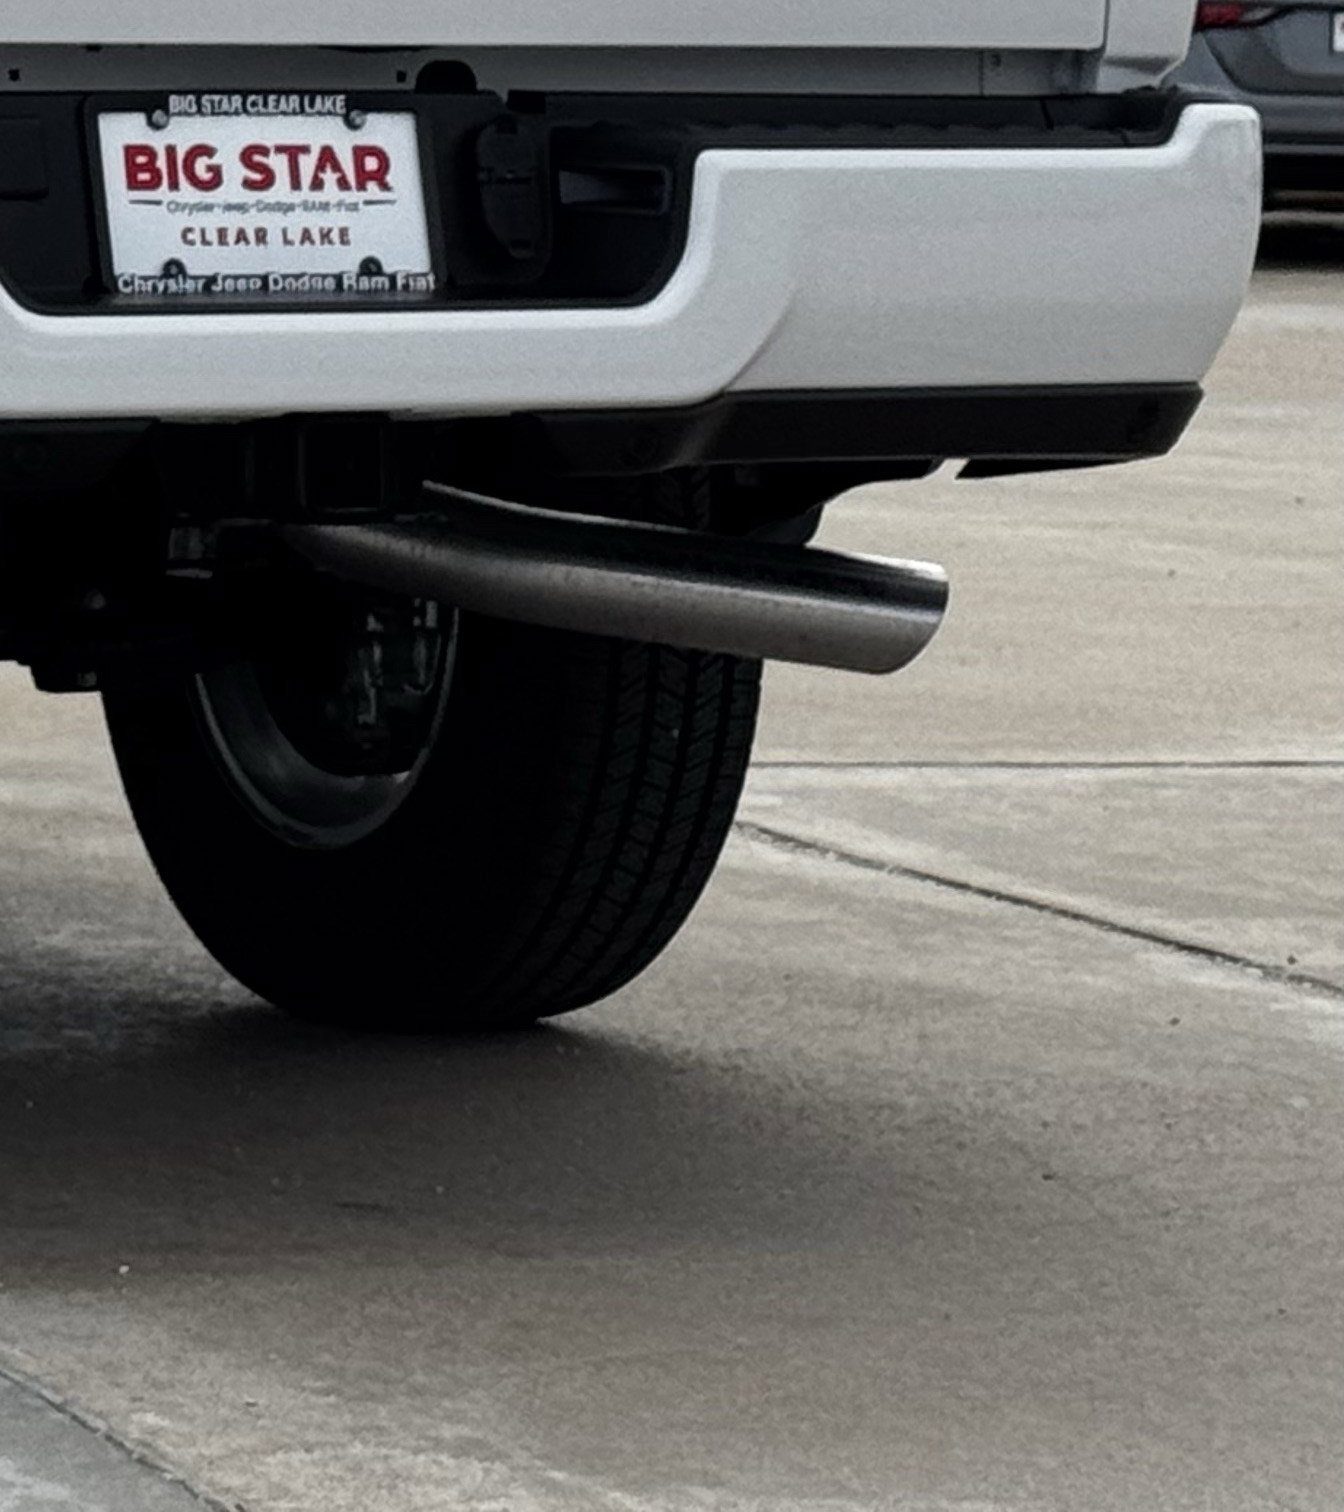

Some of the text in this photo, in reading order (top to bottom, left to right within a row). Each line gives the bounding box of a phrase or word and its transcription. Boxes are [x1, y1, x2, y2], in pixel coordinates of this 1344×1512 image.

[168, 94, 347, 115] BIG STAR CLEAR LAKE
[123, 143, 393, 192] BIG STAR
[180, 226, 352, 247] CLEAR LAKE
[342, 272, 390, 292] Ram
[395, 271, 436, 292] Fiat
